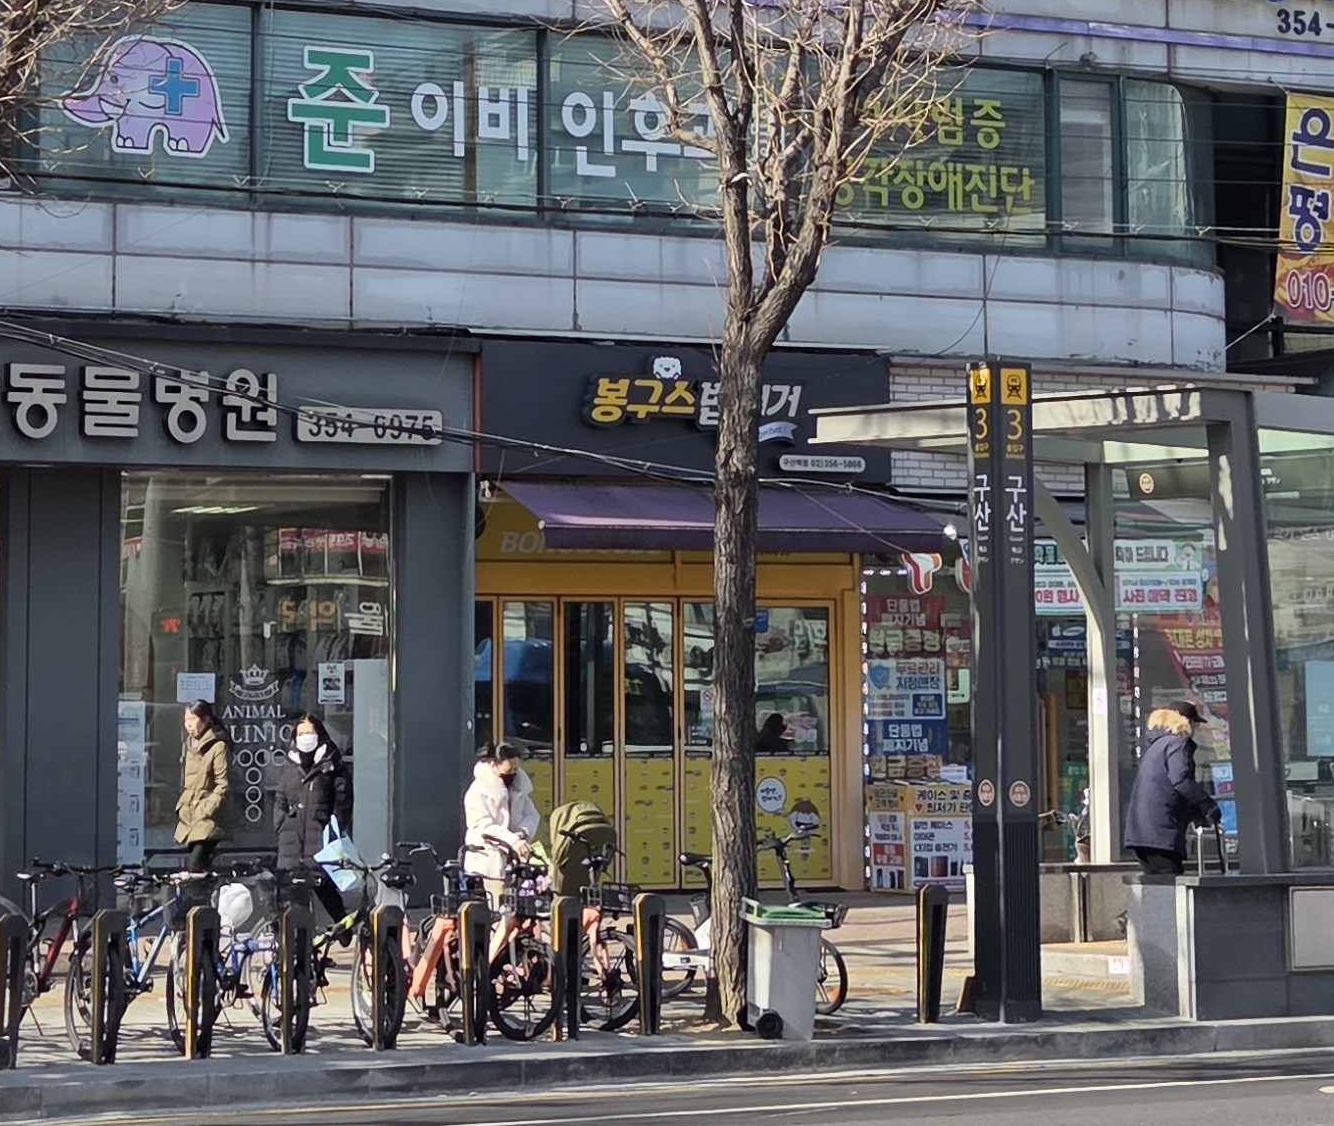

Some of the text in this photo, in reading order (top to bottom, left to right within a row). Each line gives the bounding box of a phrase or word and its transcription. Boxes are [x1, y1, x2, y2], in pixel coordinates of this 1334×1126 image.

[287, 45, 390, 173] 준
[8, 364, 278, 444] 동물병원
[975, 407, 988, 440] 3
[1007, 408, 1023, 441] 3
[973, 474, 991, 532] 구산
[1005, 475, 1027, 533] 구산
[222, 704, 287, 720] ANIMAL
[229, 724, 294, 744] LINIC
